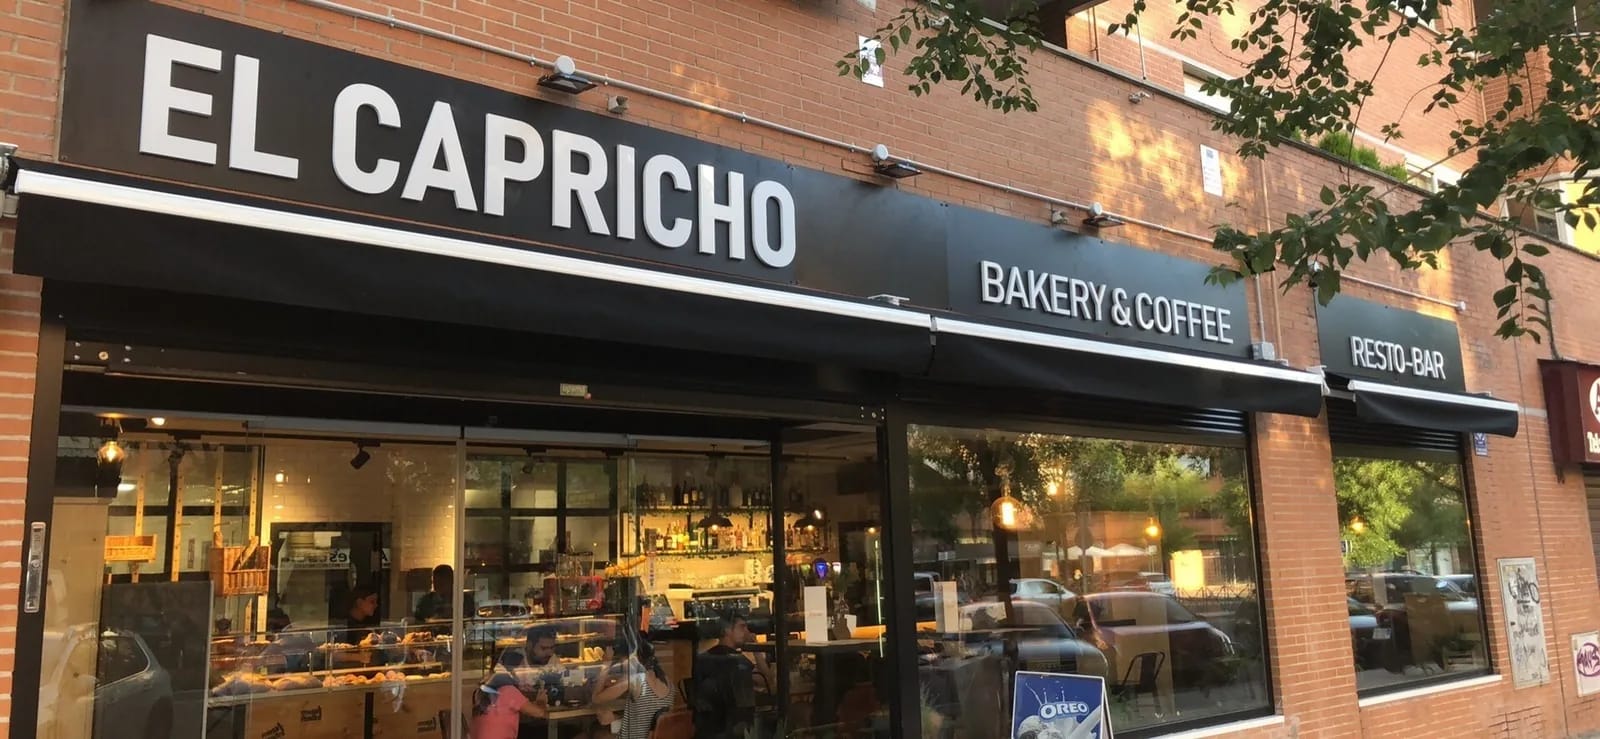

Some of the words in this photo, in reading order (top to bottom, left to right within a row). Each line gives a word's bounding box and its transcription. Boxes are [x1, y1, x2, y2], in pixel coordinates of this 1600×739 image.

[139, 34, 299, 179] EL
[332, 83, 796, 268] CAPRICHO
[981, 260, 1106, 321] BAKERY
[1111, 287, 1132, 327] &
[1135, 292, 1233, 344] COFFEE
[1350, 336, 1446, 380] RESTO-BAR
[1040, 703, 1088, 719] OREO
